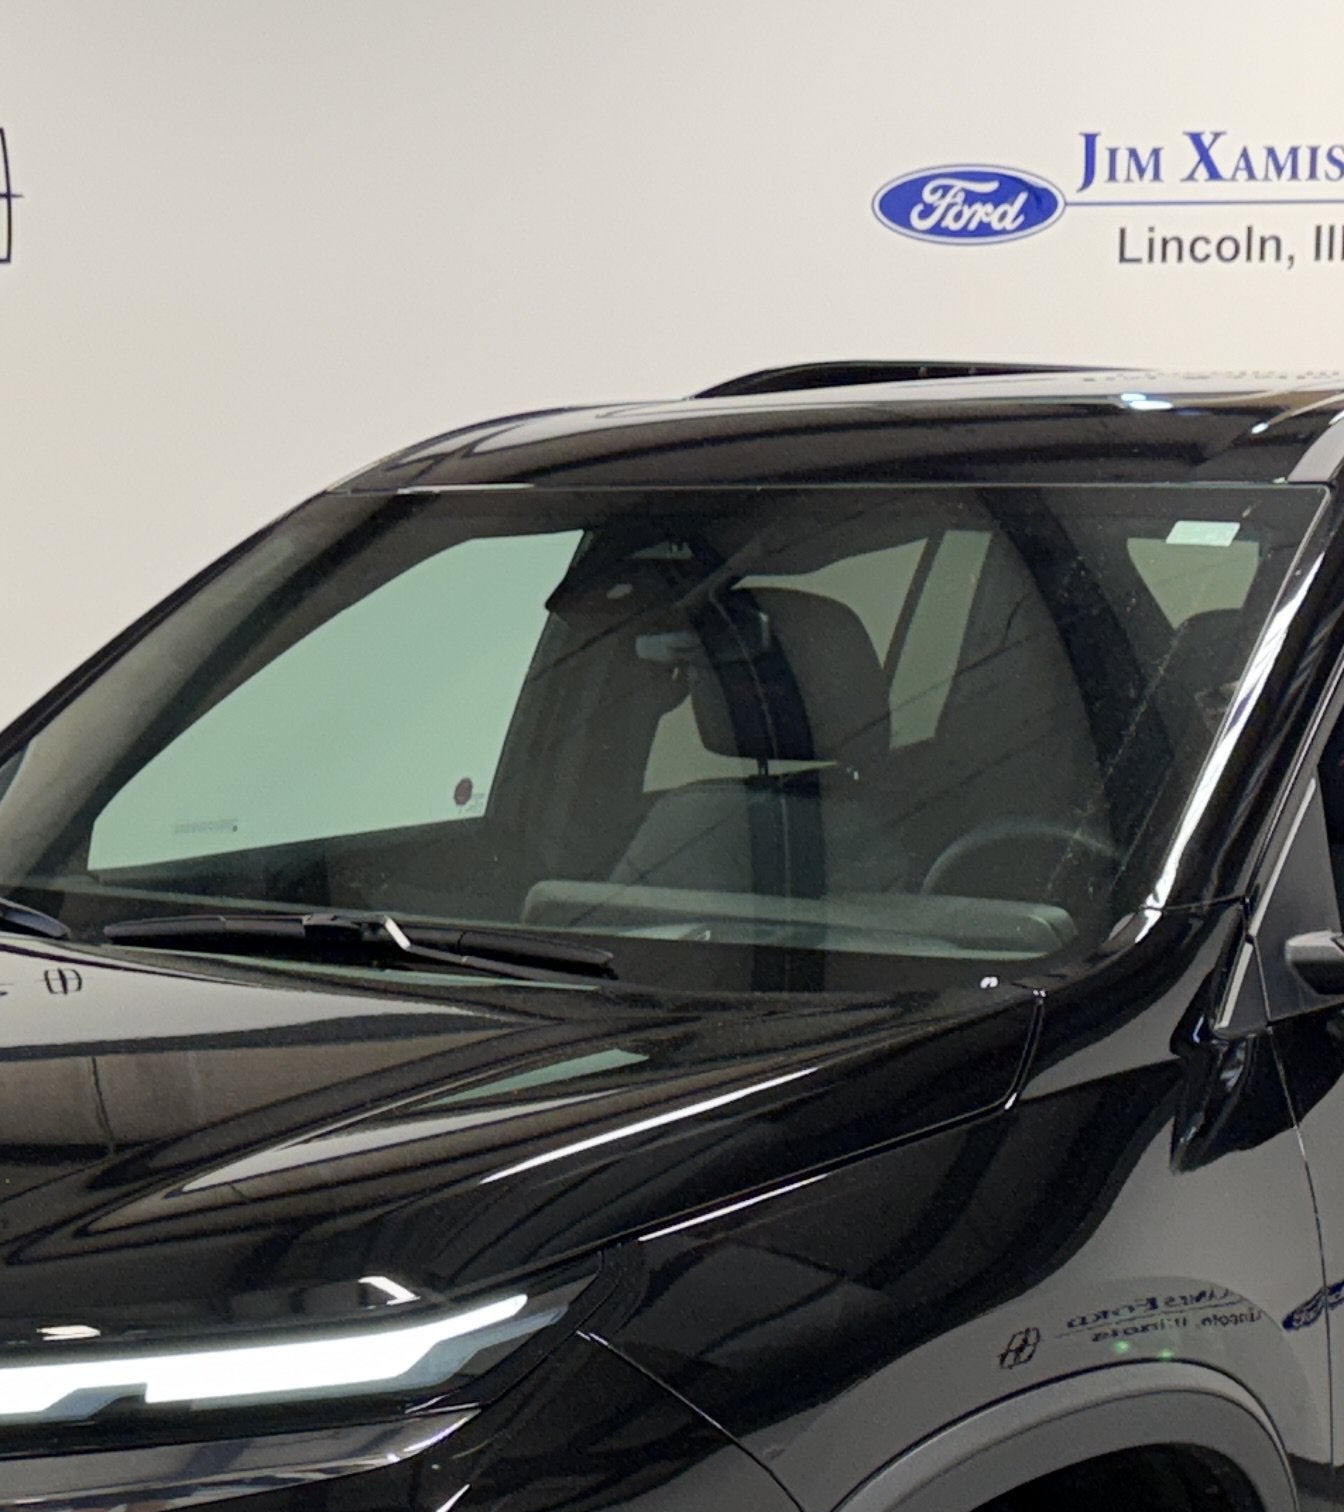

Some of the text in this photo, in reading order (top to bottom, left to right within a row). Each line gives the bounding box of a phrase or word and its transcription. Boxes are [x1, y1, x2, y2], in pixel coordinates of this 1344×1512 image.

[1077, 132, 1164, 193] JIM
[908, 177, 1027, 233] Ford
[1117, 226, 1295, 268] Lincoln,
